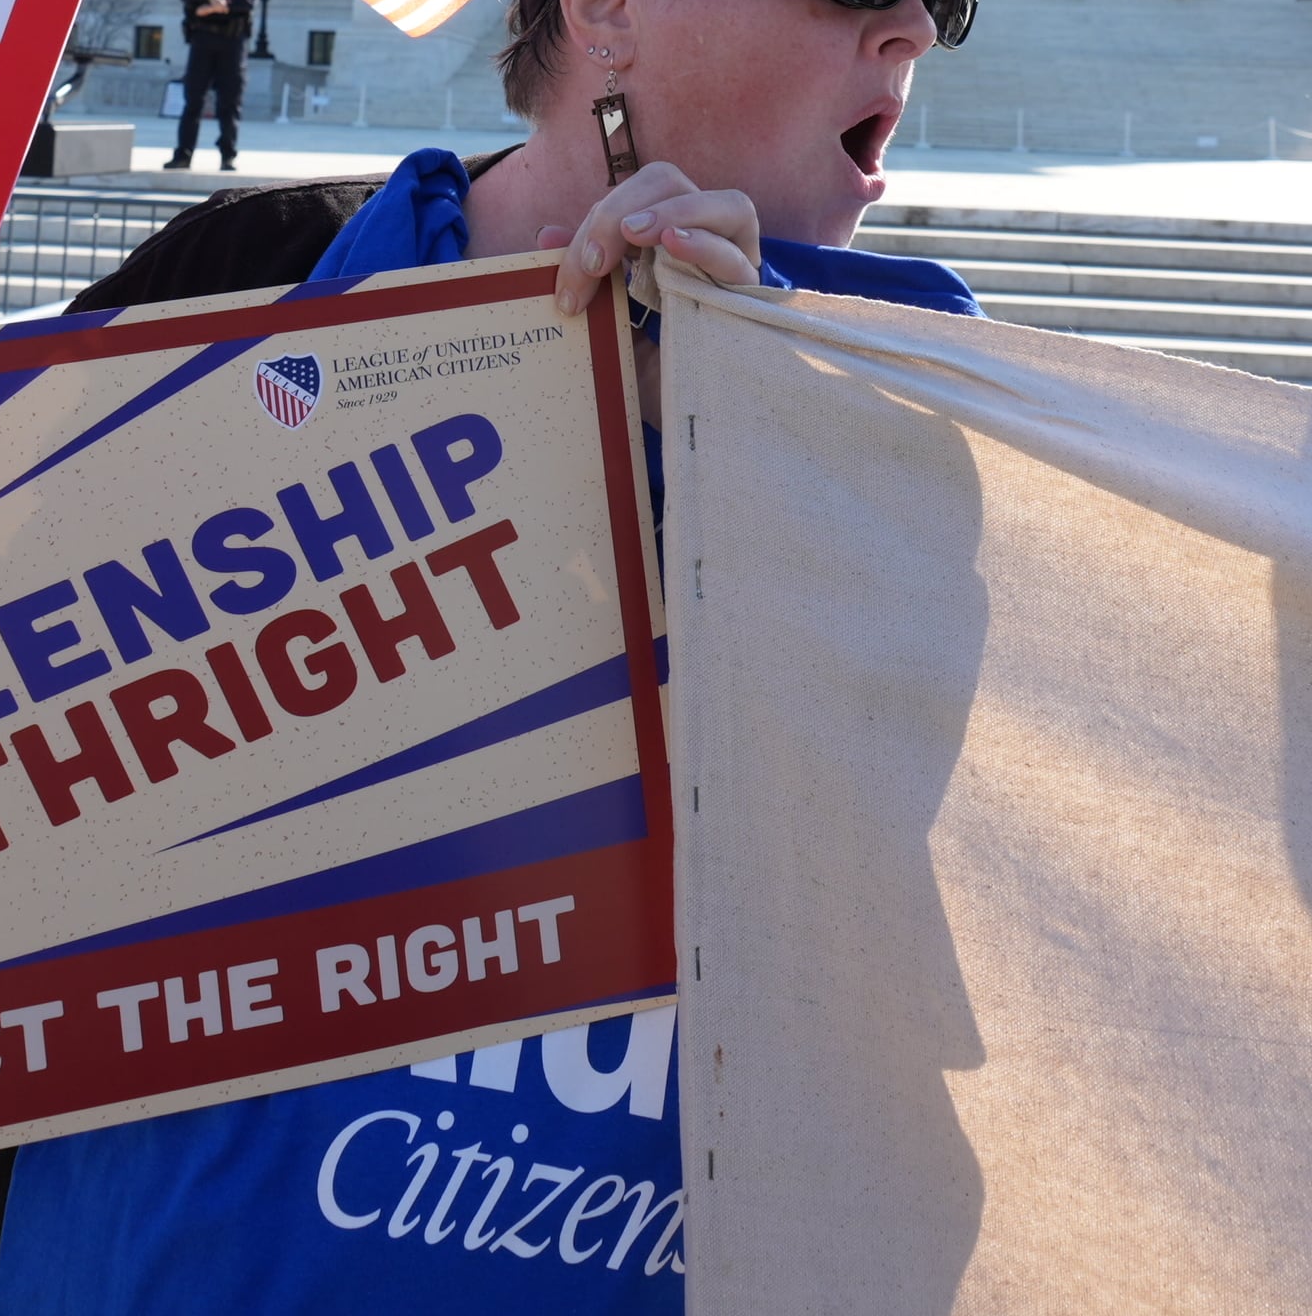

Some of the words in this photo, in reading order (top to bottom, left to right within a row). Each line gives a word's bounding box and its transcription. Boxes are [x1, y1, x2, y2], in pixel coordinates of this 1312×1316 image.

[333, 348, 410, 374] LEAGUE
[412, 344, 433, 365] of
[435, 334, 506, 358] UNITED
[510, 325, 564, 346] LATIN
[262, 368, 312, 403] LULAC
[335, 364, 433, 393] AMERICAN
[437, 350, 521, 377] CITIZENS
[336, 398, 366, 410] Since
[369, 390, 398, 405] 1929
[98, 958, 285, 1054] THE
[315, 895, 577, 1014] RIGHT
